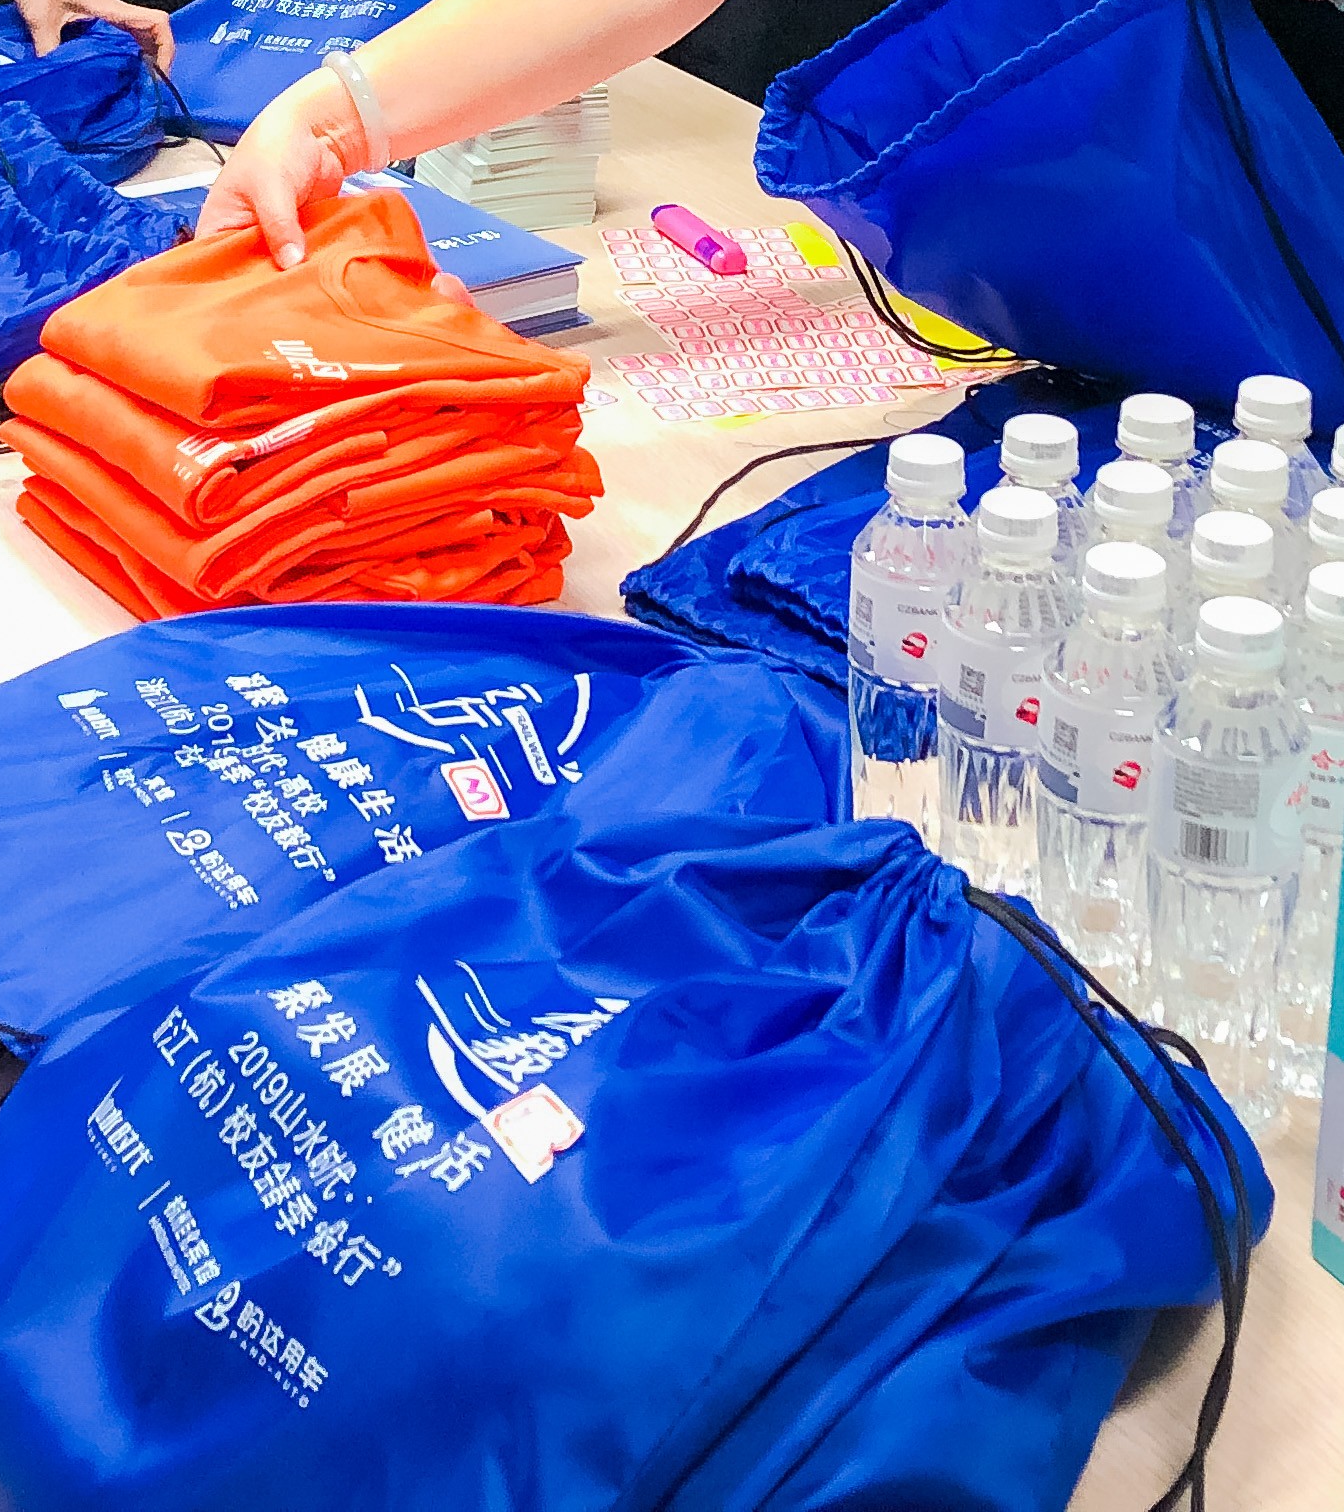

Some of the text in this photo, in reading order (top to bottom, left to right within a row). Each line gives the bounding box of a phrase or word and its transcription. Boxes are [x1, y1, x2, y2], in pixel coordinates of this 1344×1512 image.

[294, 732, 423, 865] 健康生活
[267, 978, 391, 1097] 聚发展
[236, 1299, 330, 1395] 盼达用车
